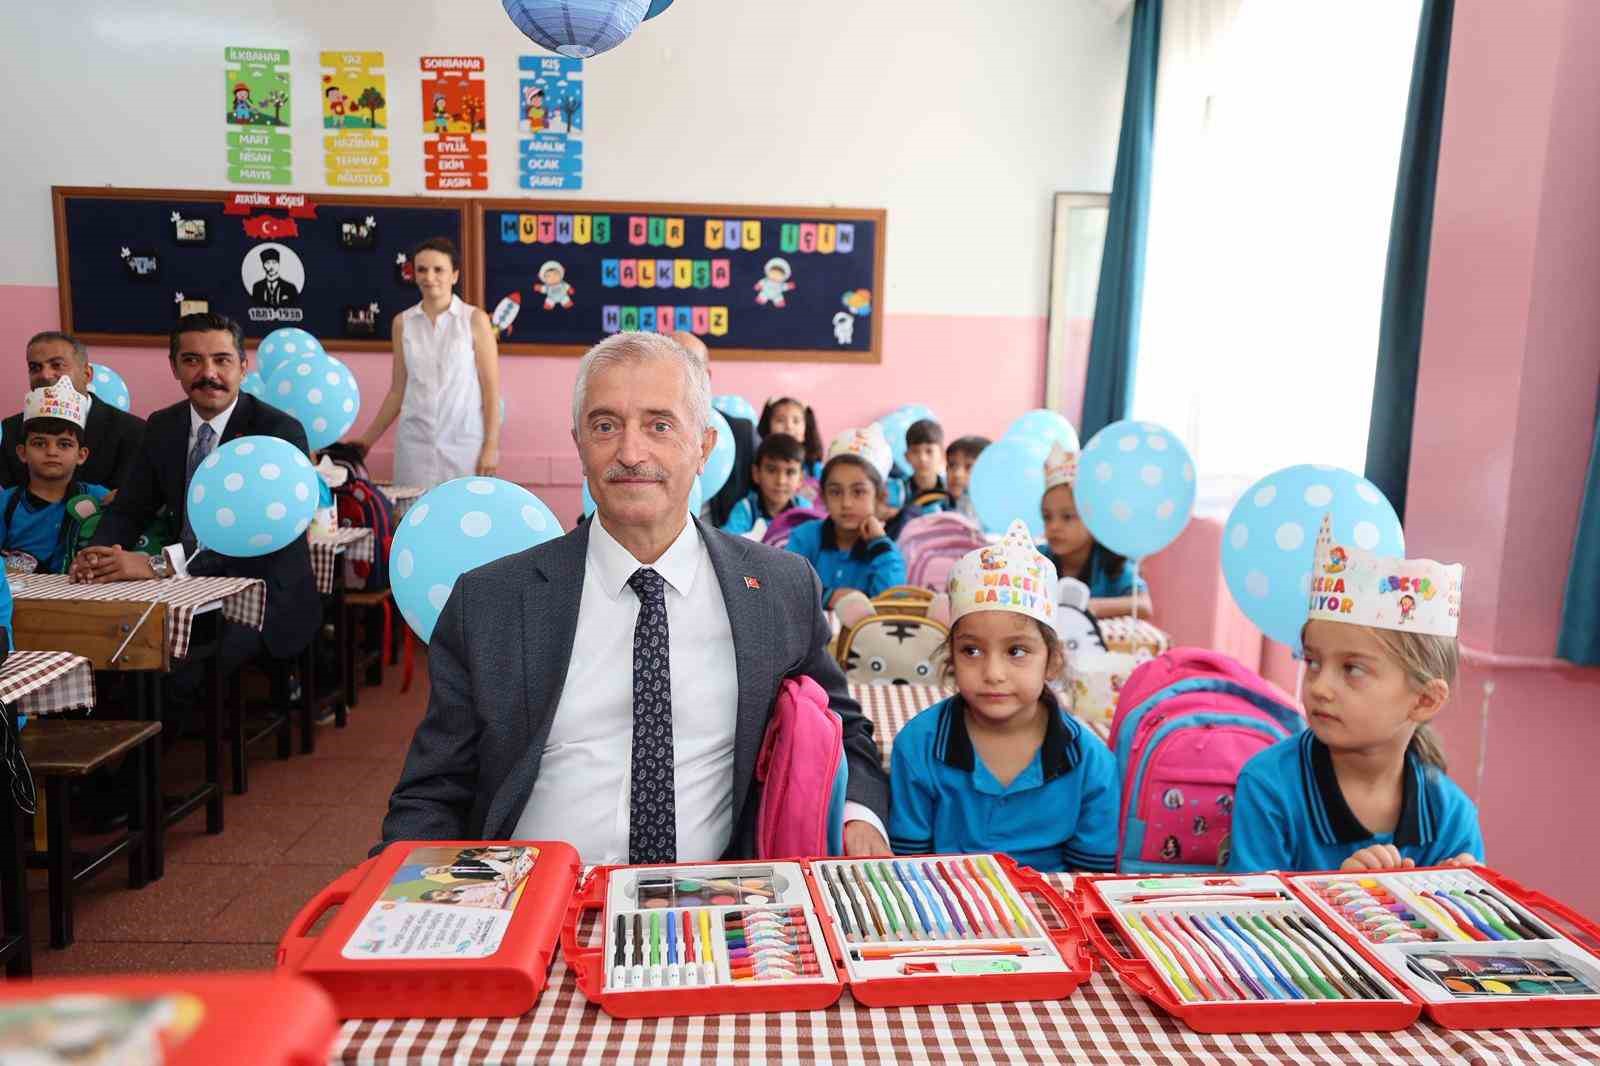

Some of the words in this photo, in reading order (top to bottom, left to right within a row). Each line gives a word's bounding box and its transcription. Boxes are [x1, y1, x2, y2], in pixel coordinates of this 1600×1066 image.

[424, 58, 481, 70] SONBAHAR
[541, 58, 561, 71] KIŞ
[239, 134, 270, 145] MART
[437, 141, 470, 153] EYLÜL
[528, 142, 566, 153] ARALIK
[438, 158, 465, 170] EKİM
[528, 159, 560, 170] OCAK
[239, 169, 272, 181] MAYIS
[438, 177, 472, 188] KASIM
[529, 176, 564, 189] ŞUBAT
[633, 217, 685, 239] BİR
[710, 225, 756, 242] YIL
[605, 265, 727, 285] KALKIŞA
[606, 312, 724, 327] HAZIRIZ
